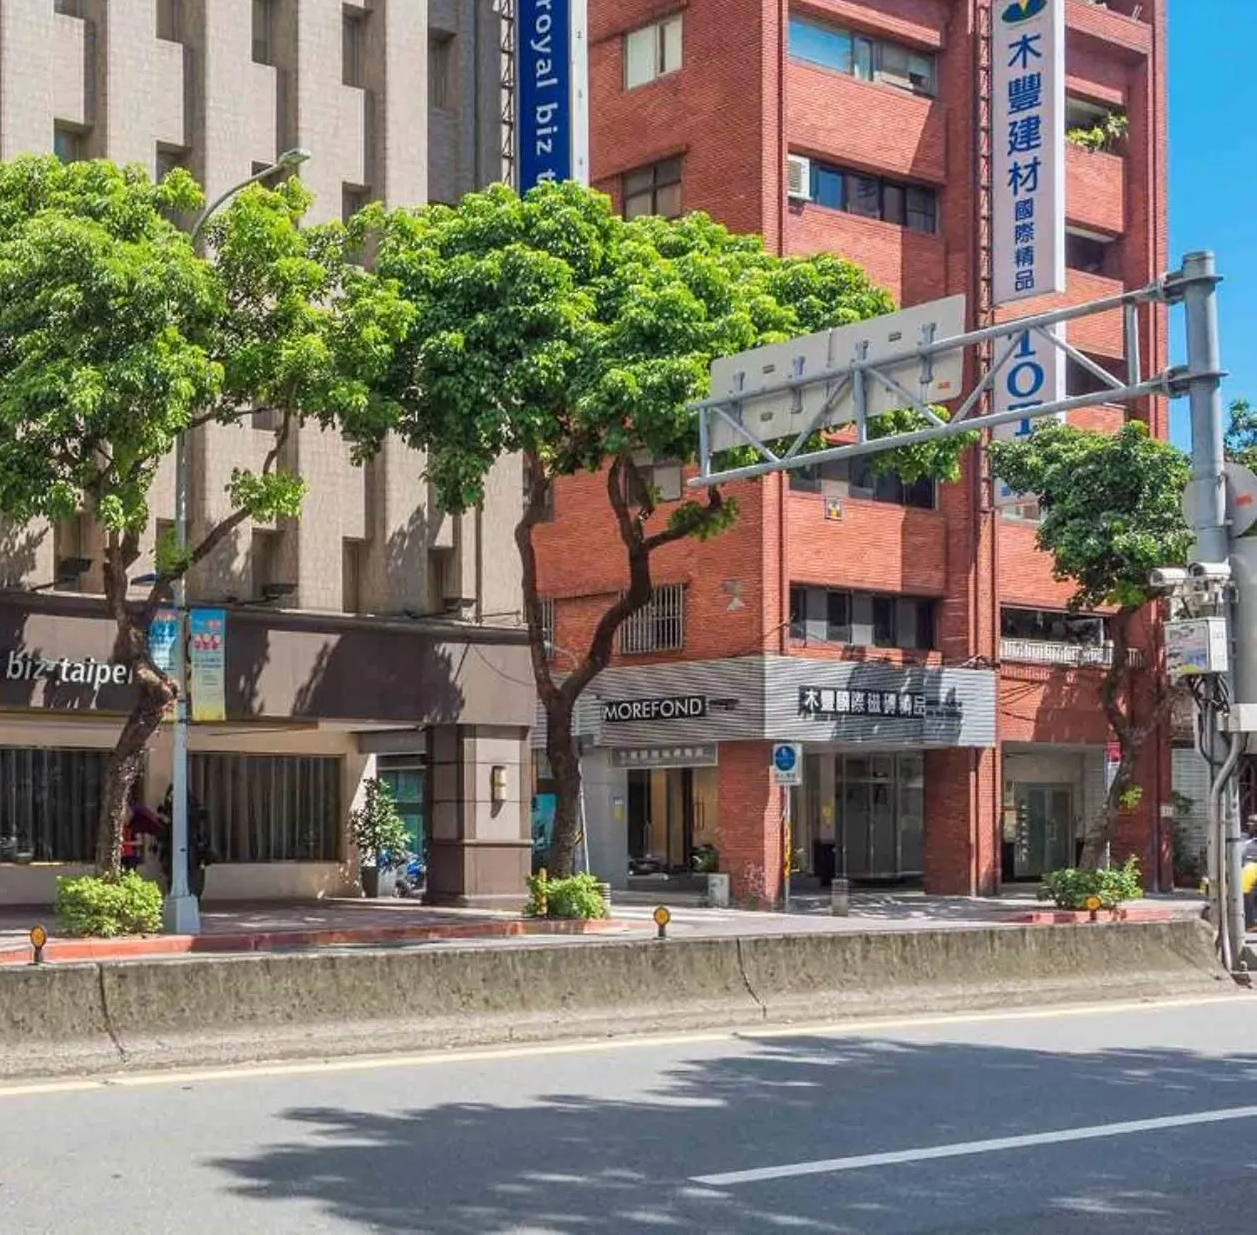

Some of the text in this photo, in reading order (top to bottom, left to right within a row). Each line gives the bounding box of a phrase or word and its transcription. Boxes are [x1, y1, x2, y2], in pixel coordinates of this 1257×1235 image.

[536, 101, 559, 156] biz
[1007, 33, 1042, 292] 木豐建材 國際精品
[6, 650, 49, 680] biz
[603, 697, 703, 721] MOREFOND
